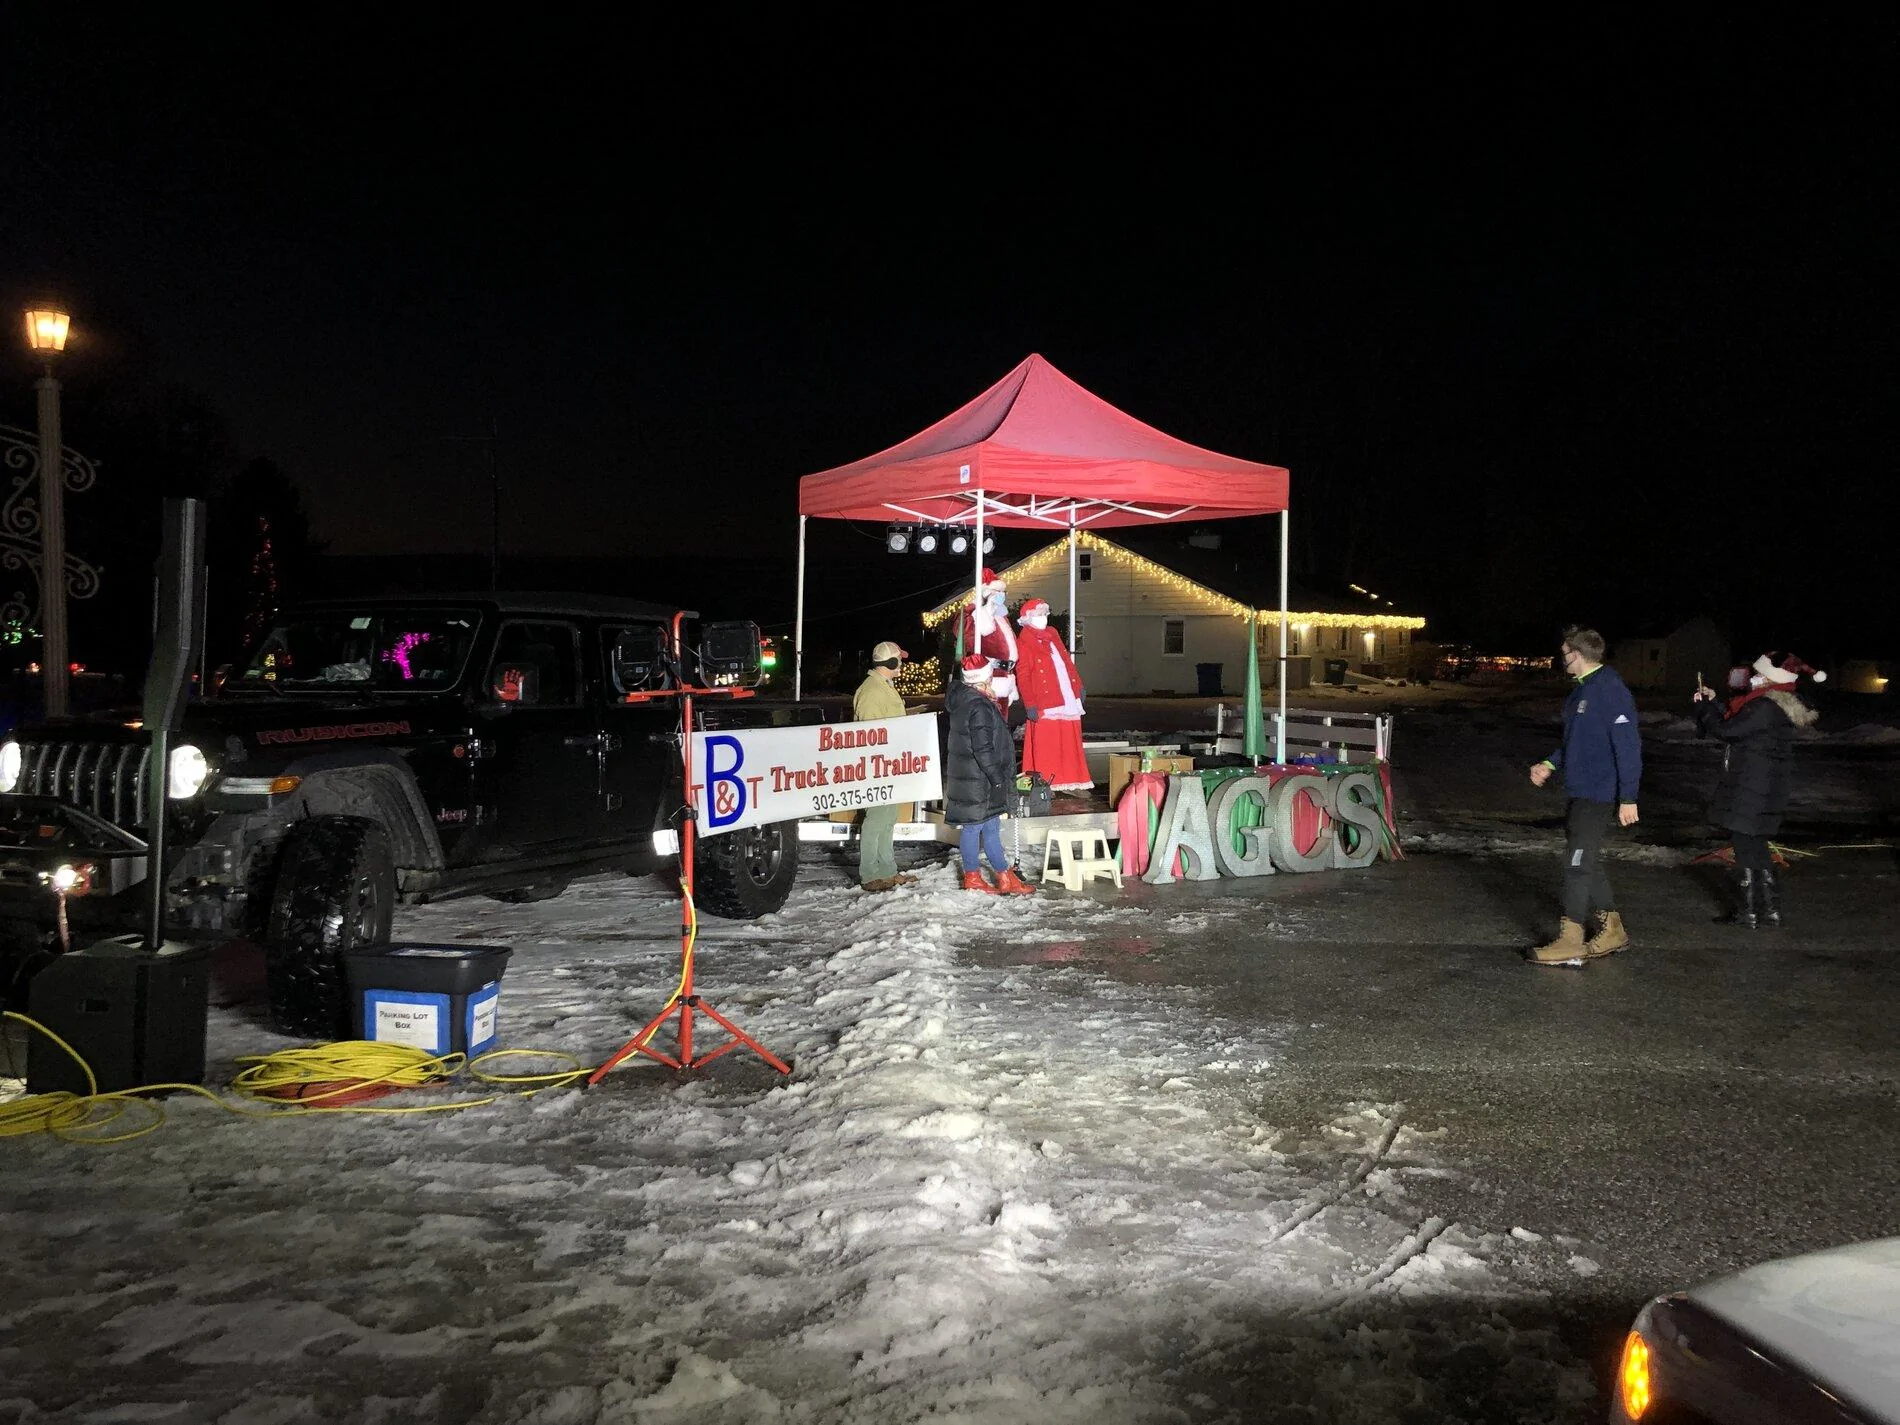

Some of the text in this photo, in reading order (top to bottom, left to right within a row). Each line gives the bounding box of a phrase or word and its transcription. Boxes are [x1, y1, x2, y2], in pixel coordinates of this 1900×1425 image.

[255, 720, 411, 745] RUBICON
[818, 726, 889, 751] Bannon
[770, 751, 931, 793] Truck and Trailer
[812, 785, 895, 811] 302-375-6767
[435, 807, 468, 823] Jeep
[1141, 772, 1383, 885] AGCS
[394, 1021, 412, 1029] BOX
